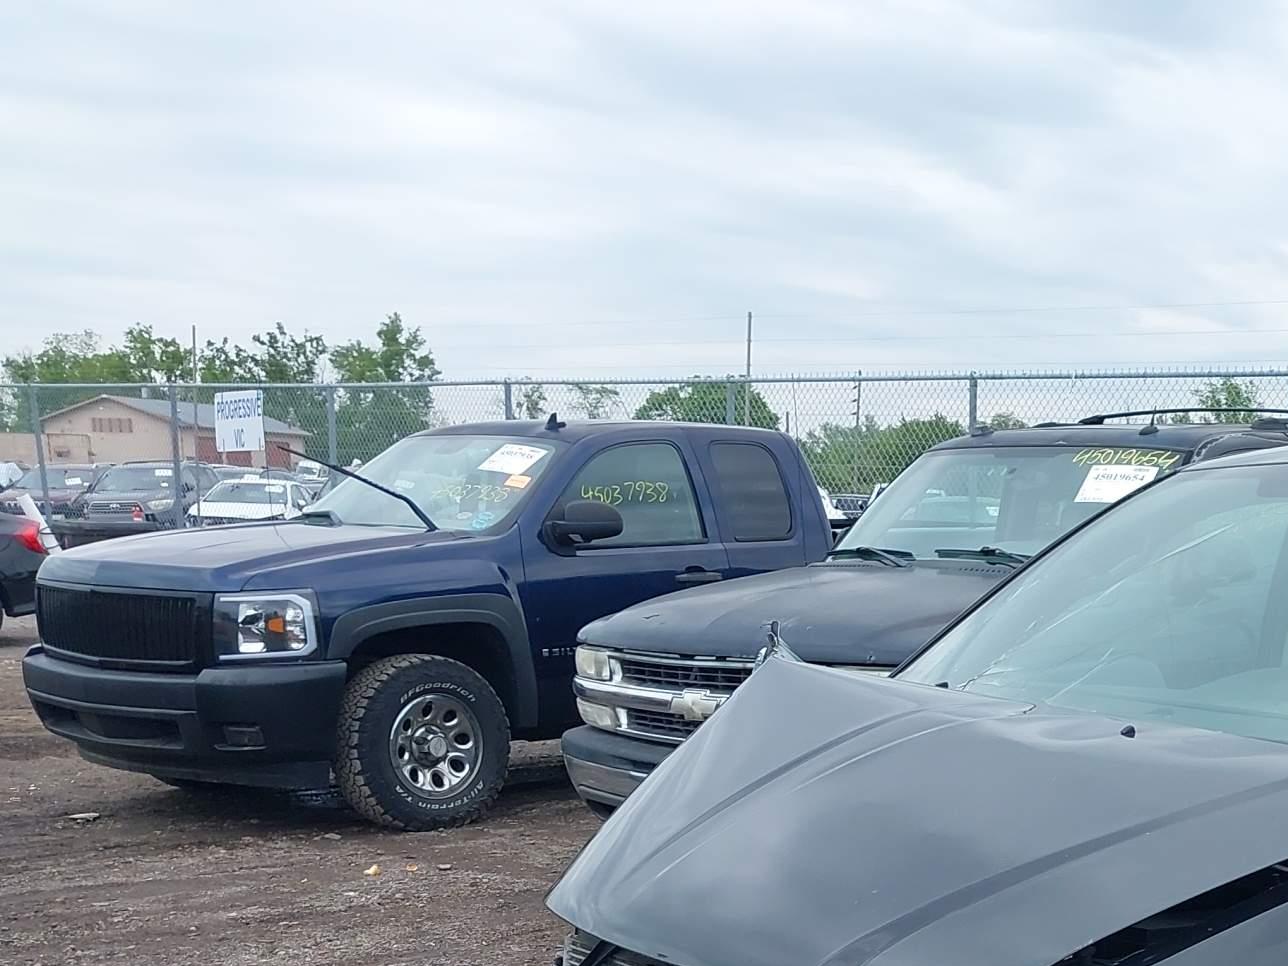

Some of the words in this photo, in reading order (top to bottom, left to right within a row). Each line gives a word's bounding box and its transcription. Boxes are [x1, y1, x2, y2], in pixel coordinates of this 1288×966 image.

[217, 397, 262, 420] PROGRESSIVE
[1072, 448, 1180, 470] 45019654
[581, 481, 669, 506] 45037938
[399, 681, 476, 705] BFGoodrich
